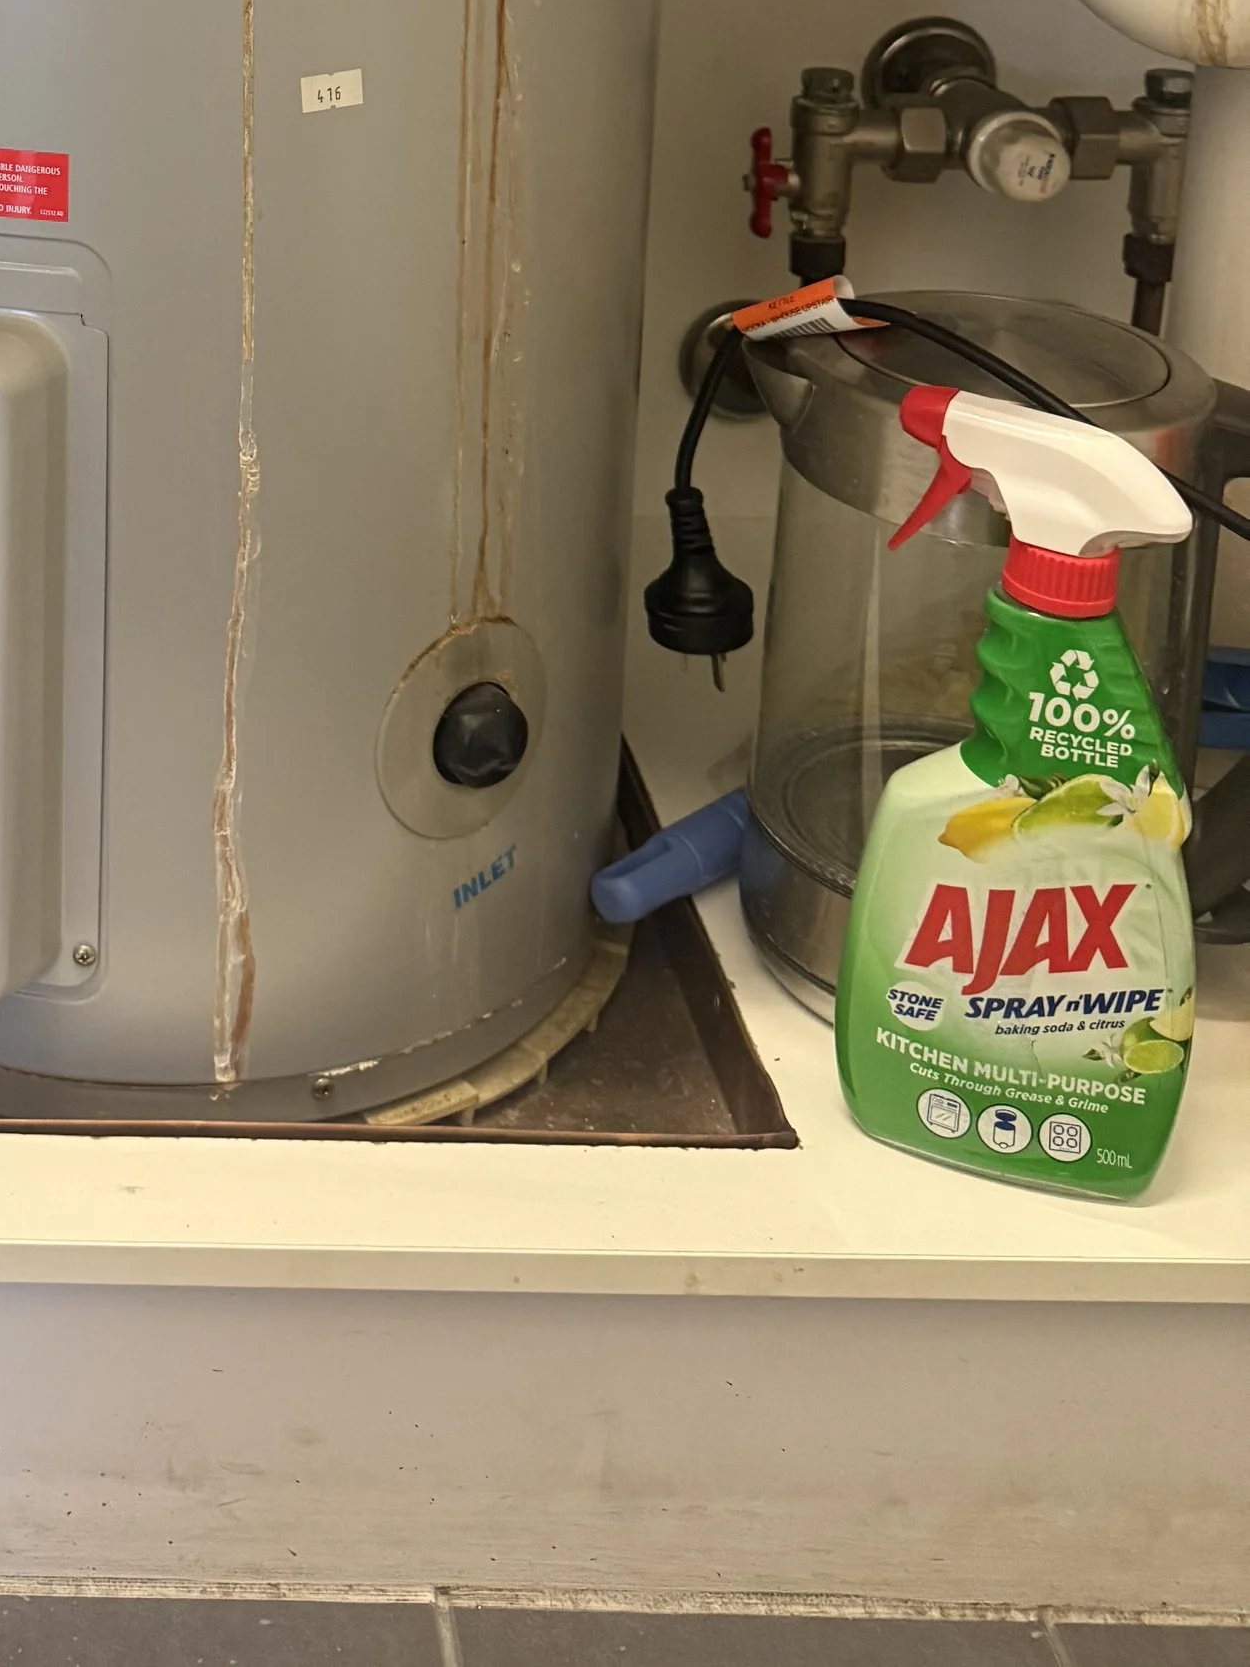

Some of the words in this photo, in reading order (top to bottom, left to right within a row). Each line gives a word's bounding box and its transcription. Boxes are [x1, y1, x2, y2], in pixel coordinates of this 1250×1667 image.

[317, 85, 341, 103] 416
[15, 164, 61, 176] DANGEROUS
[34, 186, 48, 195] THE
[5, 204, 32, 215] INJURY.
[1029, 691, 1136, 740] 100%
[1030, 726, 1133, 756] RECYCLED
[1040, 744, 1119, 768] BOTTLE
[453, 843, 516, 909] INLET
[904, 883, 1137, 995] AJAX
[887, 989, 944, 1009] STONE
[964, 994, 1066, 1020] SPRAY
[894, 1004, 938, 1021] SAFE
[995, 1024, 1041, 1036] baking
[1043, 1021, 1073, 1033] soda
[1077, 1021, 1085, 1031] &
[1088, 1019, 1126, 1031] citrus
[875, 1026, 968, 1075] KITCHEN
[973, 1060, 1147, 1105] MULTI-PURPOSE
[909, 1061, 940, 1081] Cuts
[943, 1072, 1001, 1097] Through
[1005, 1087, 1052, 1105] Grease
[1055, 1095, 1064, 1105] &
[1067, 1096, 1109, 1114] Grime
